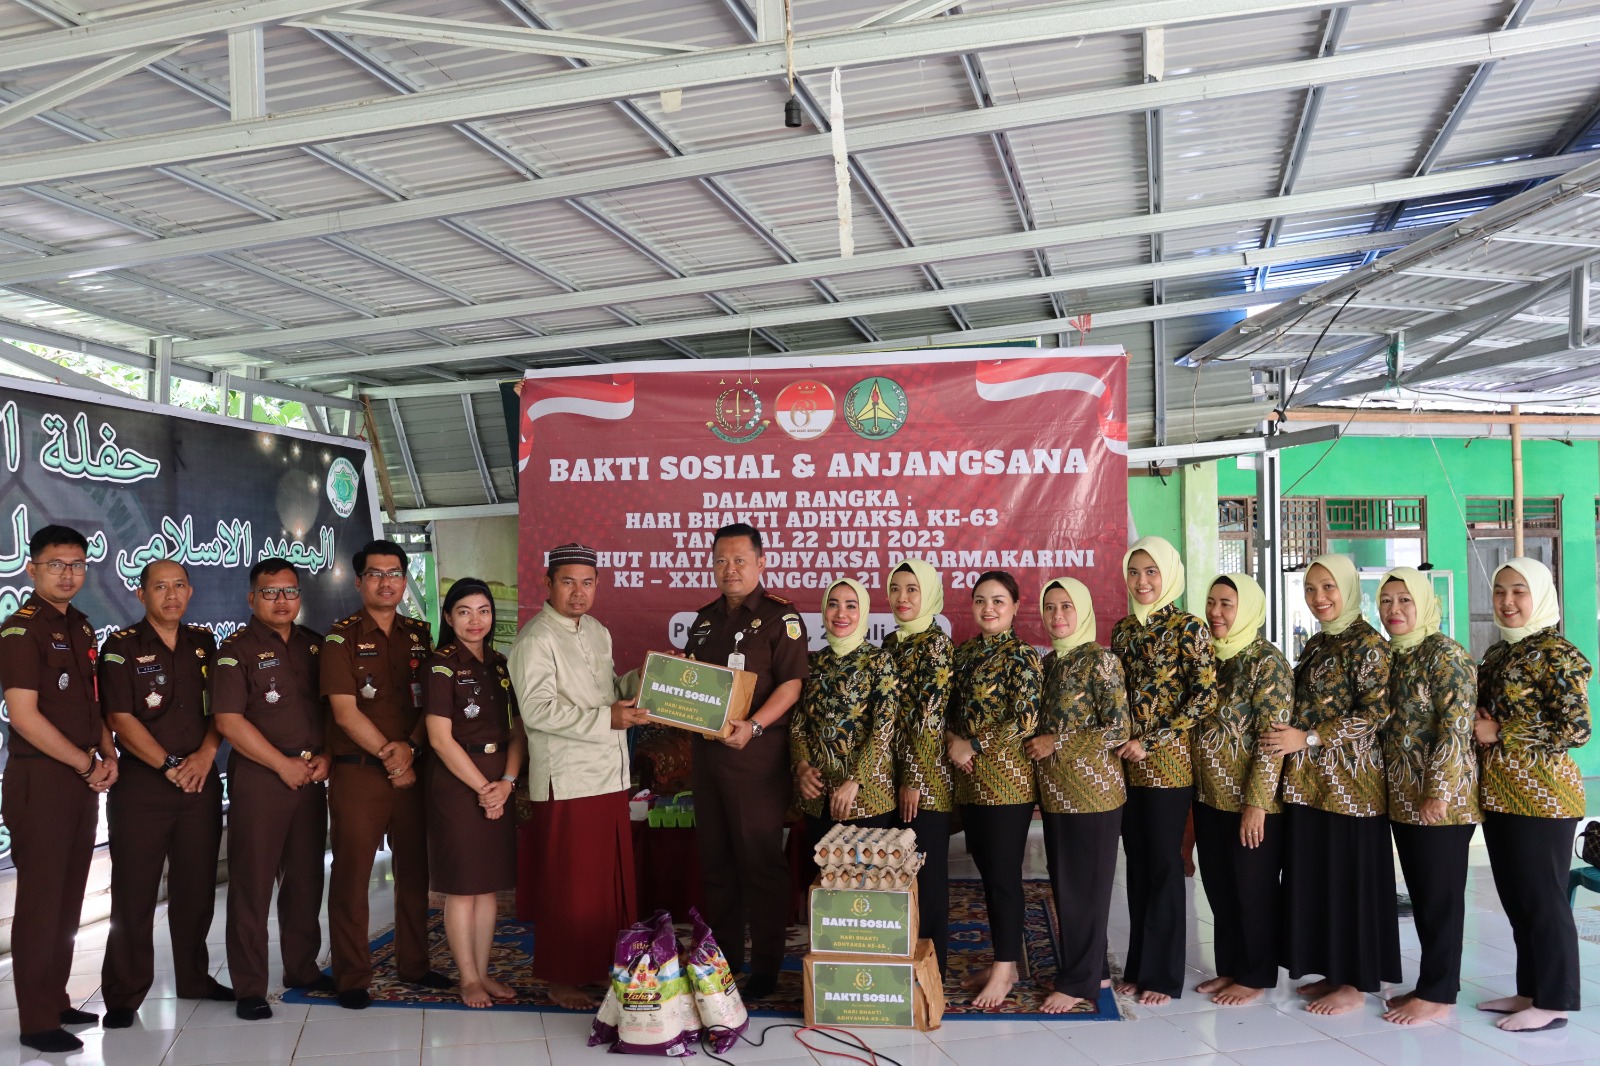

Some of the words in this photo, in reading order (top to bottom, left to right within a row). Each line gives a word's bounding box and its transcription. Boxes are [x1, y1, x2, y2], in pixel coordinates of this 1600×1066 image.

[40, 412, 160, 484] حفلة
[549, 457, 650, 482] BAKTI
[659, 454, 781, 481] SOSIAL
[791, 453, 816, 478] &
[827, 447, 1089, 478] ANJANGSANA
[702, 491, 788, 509] DALAM
[795, 489, 900, 508] RANGKA
[625, 512, 681, 529] HARI
[688, 511, 779, 529] BHAKTI
[785, 509, 920, 528] ADHYAKSA
[926, 508, 999, 527] KE-63
[672, 531, 785, 549] TANAL
[792, 531, 819, 548] 22
[826, 530, 880, 548] JULI
[888, 530, 945, 548] 2023
[596, 551, 643, 568] HUT
[764, 551, 881, 568] DHYAKSA
[613, 571, 645, 588] KE
[856, 571, 881, 589] 21
[651, 681, 684, 697] BAKTI
[684, 690, 722, 706] SOSIAL
[822, 917, 858, 927] BAKTI
[859, 919, 902, 930] SOSIAL
[824, 991, 861, 1002] BAKTI
[862, 993, 905, 1003] SOSIAL
